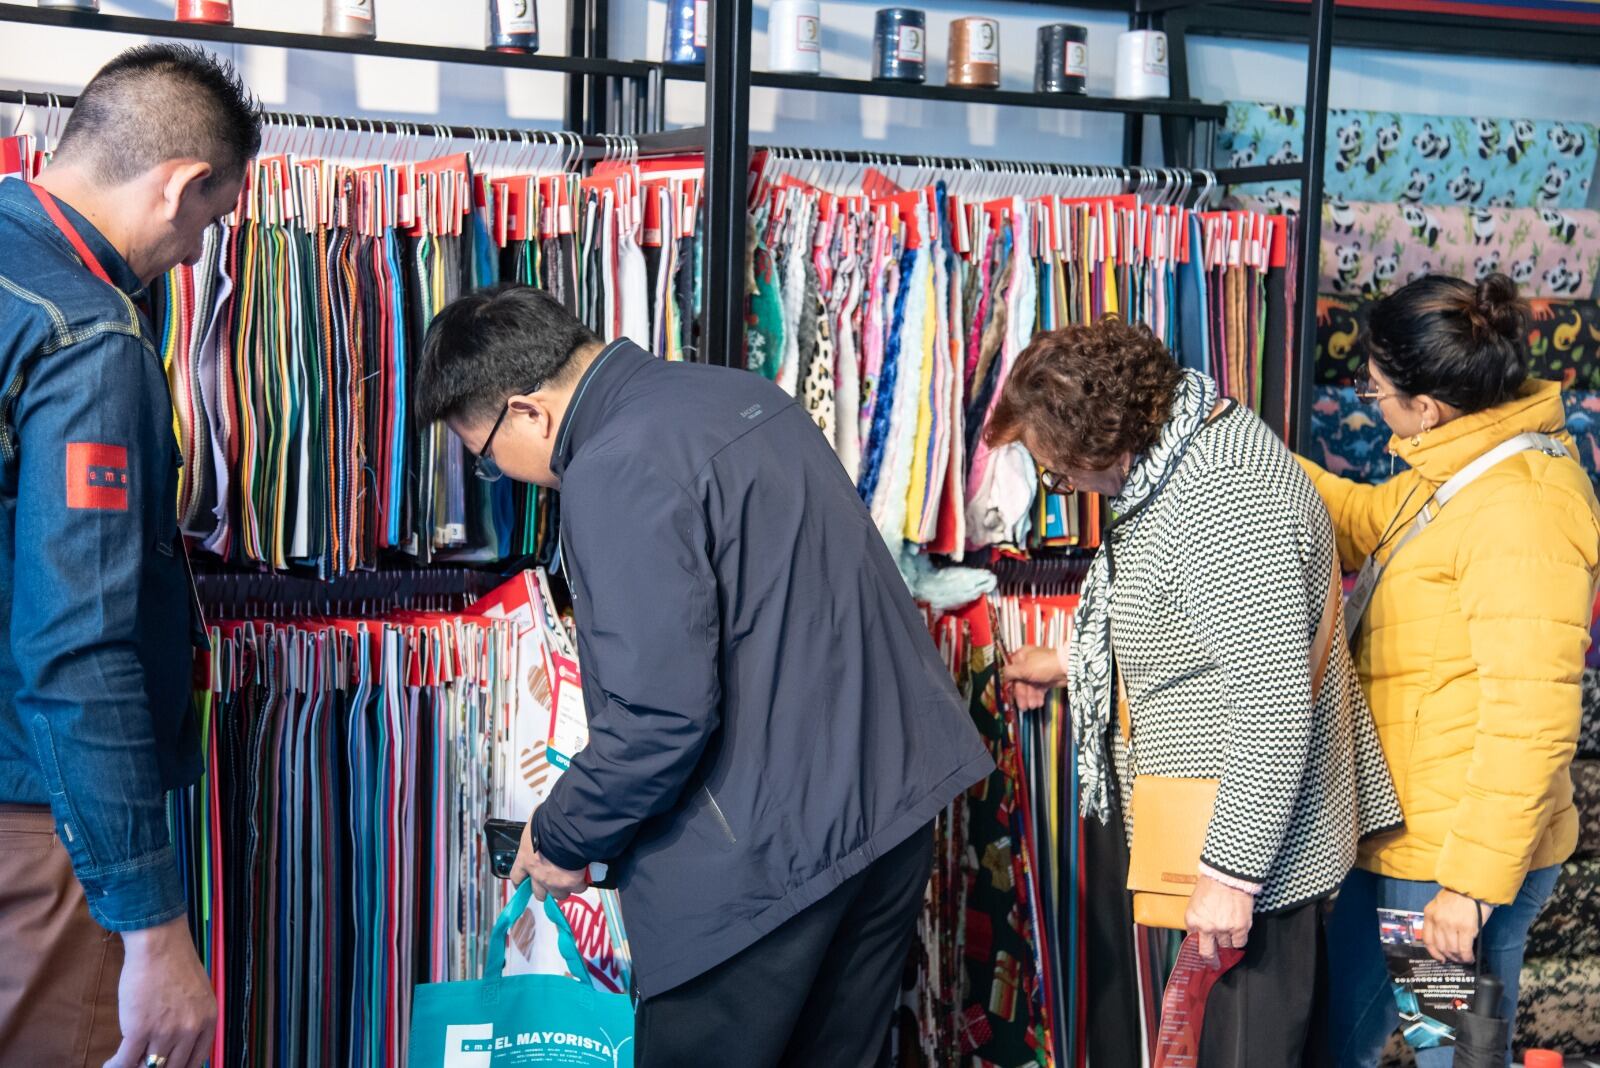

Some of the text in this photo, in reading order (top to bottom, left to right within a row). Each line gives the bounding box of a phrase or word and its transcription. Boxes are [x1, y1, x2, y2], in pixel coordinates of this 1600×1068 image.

[89, 471, 127, 483] ema
[495, 1037, 512, 1050] EL
[517, 1032, 611, 1057] MAYORISTA
